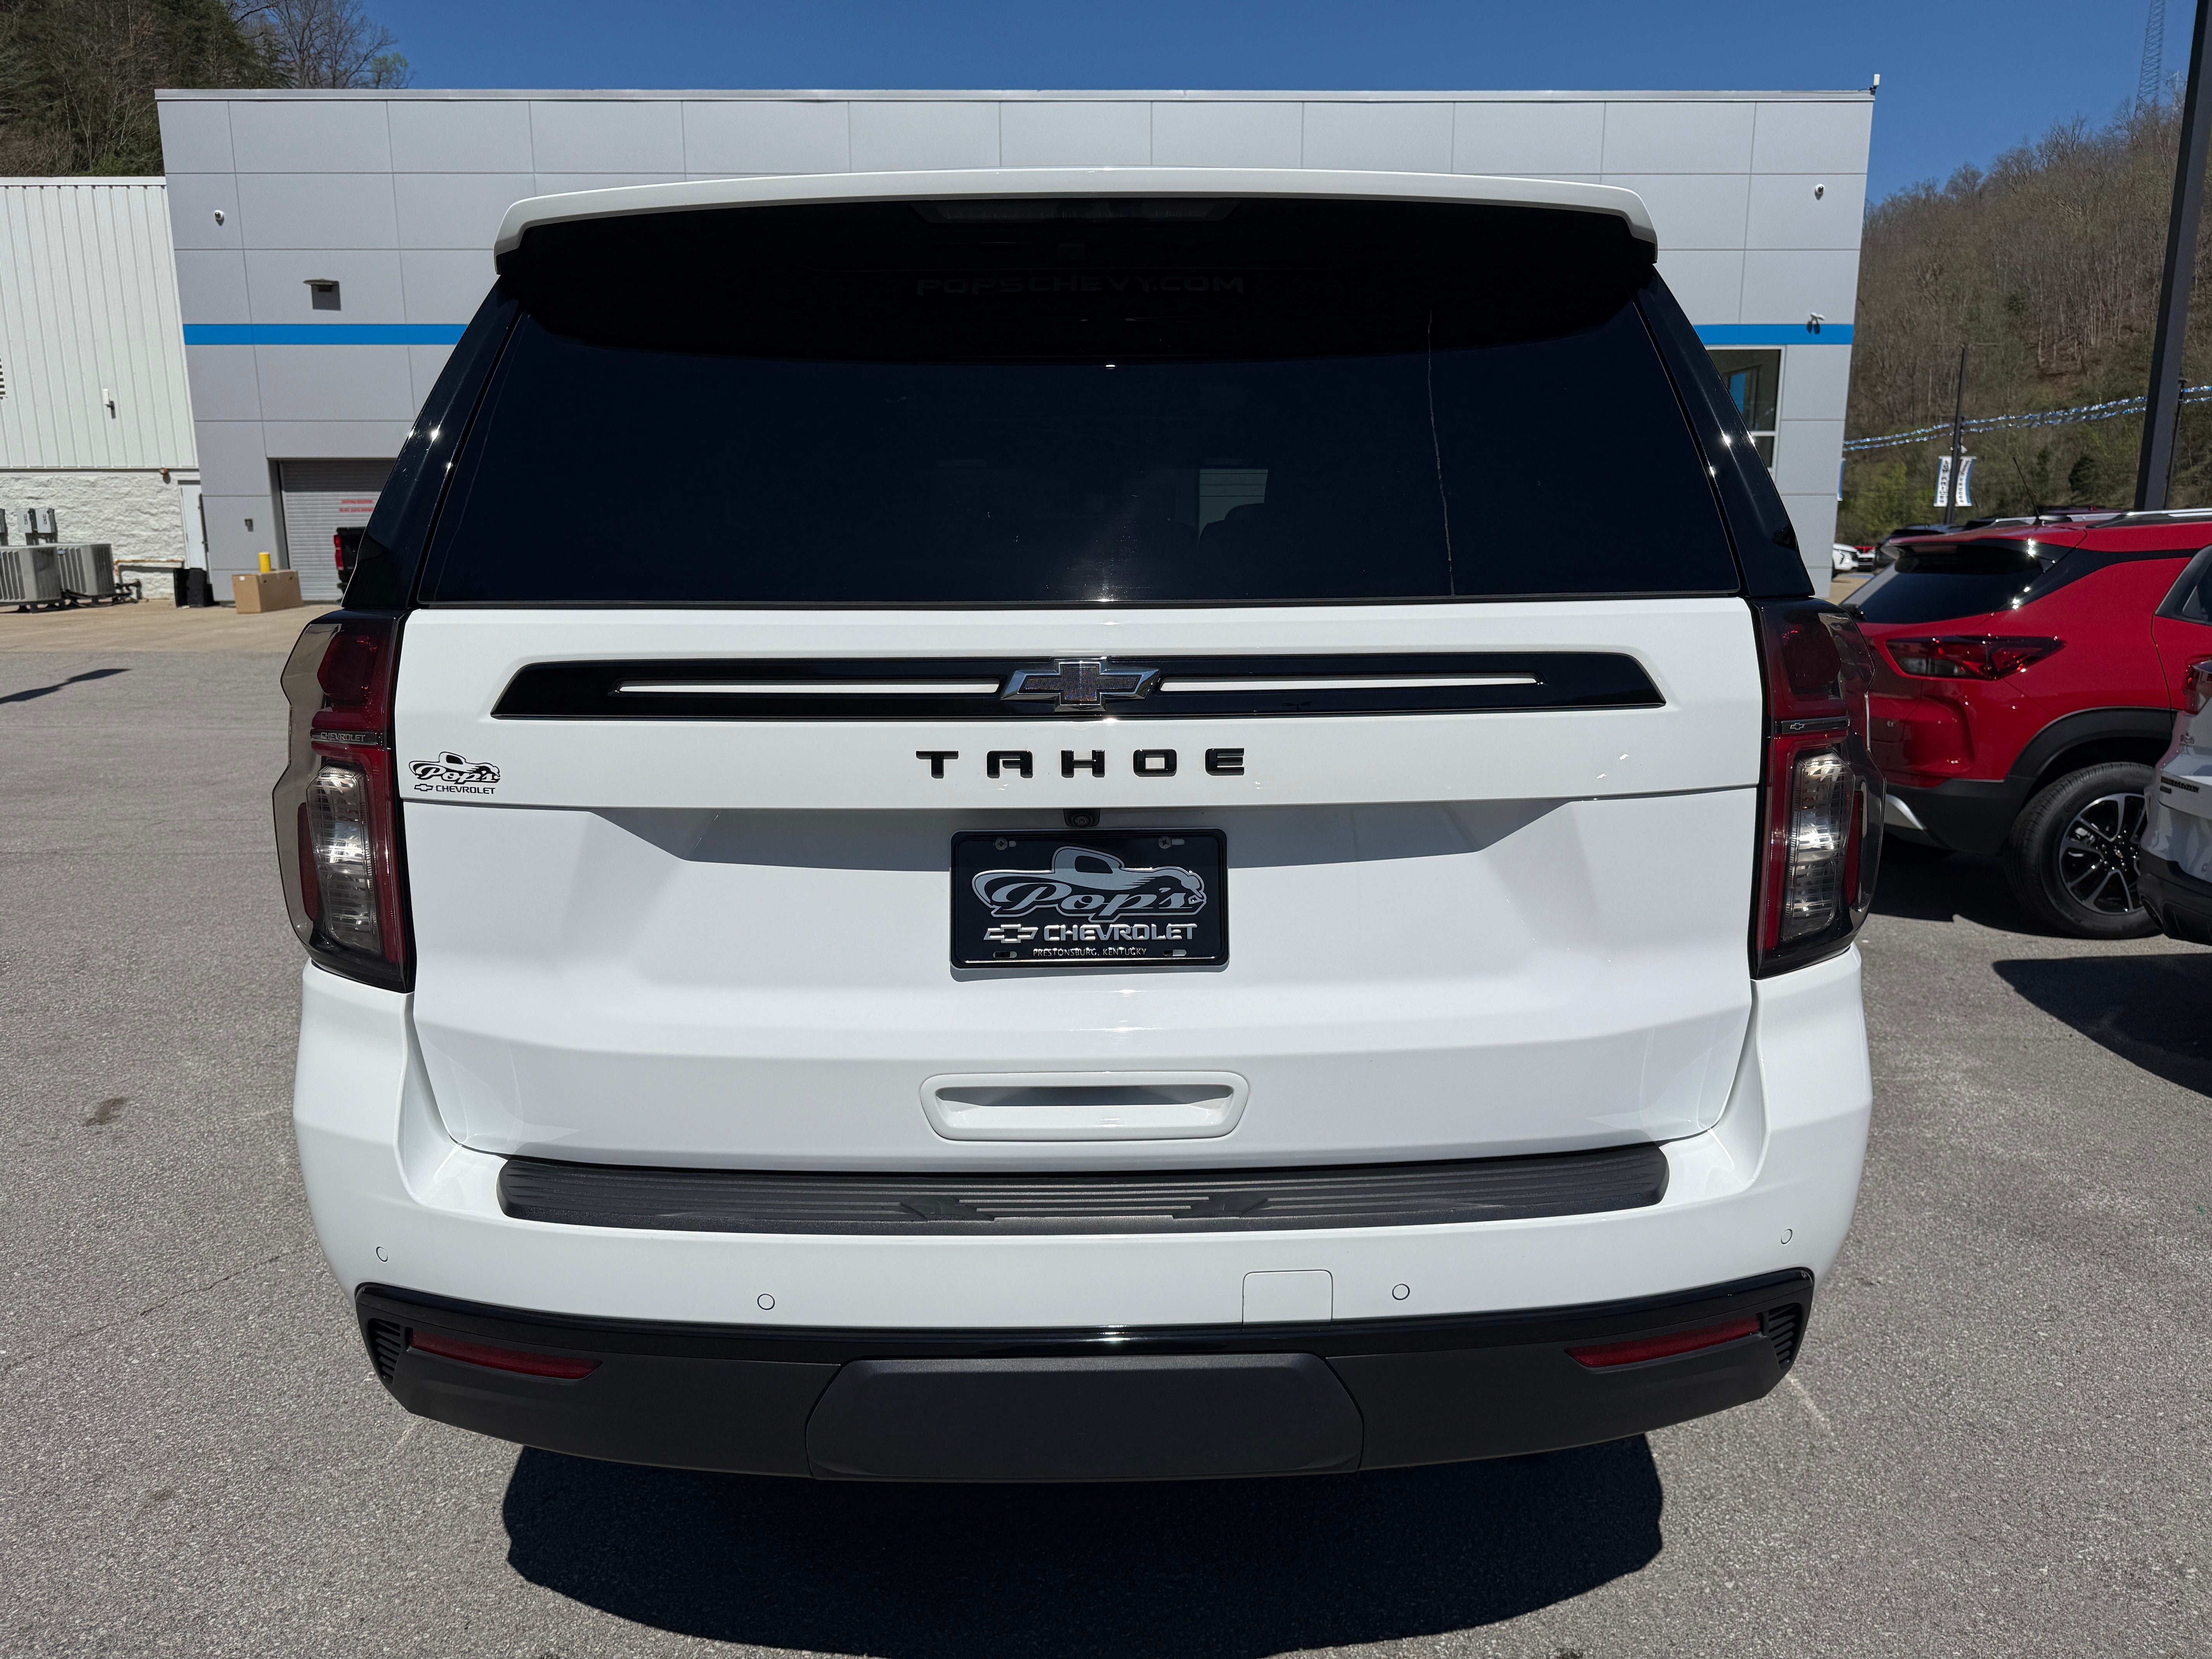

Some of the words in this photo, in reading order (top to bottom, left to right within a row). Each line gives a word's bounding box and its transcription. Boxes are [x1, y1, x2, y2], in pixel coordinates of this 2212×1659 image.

[917, 274, 1244, 296] POPSCHEVY.COM
[321, 732, 365, 742] CHEVROLET
[916, 748, 1244, 778] TAHOE
[436, 785, 495, 794] CHEVROLET
[991, 882, 1193, 916] Pop's
[1043, 924, 1197, 941] CHEVROLET
[1103, 947, 1147, 956] KENTUCKY
